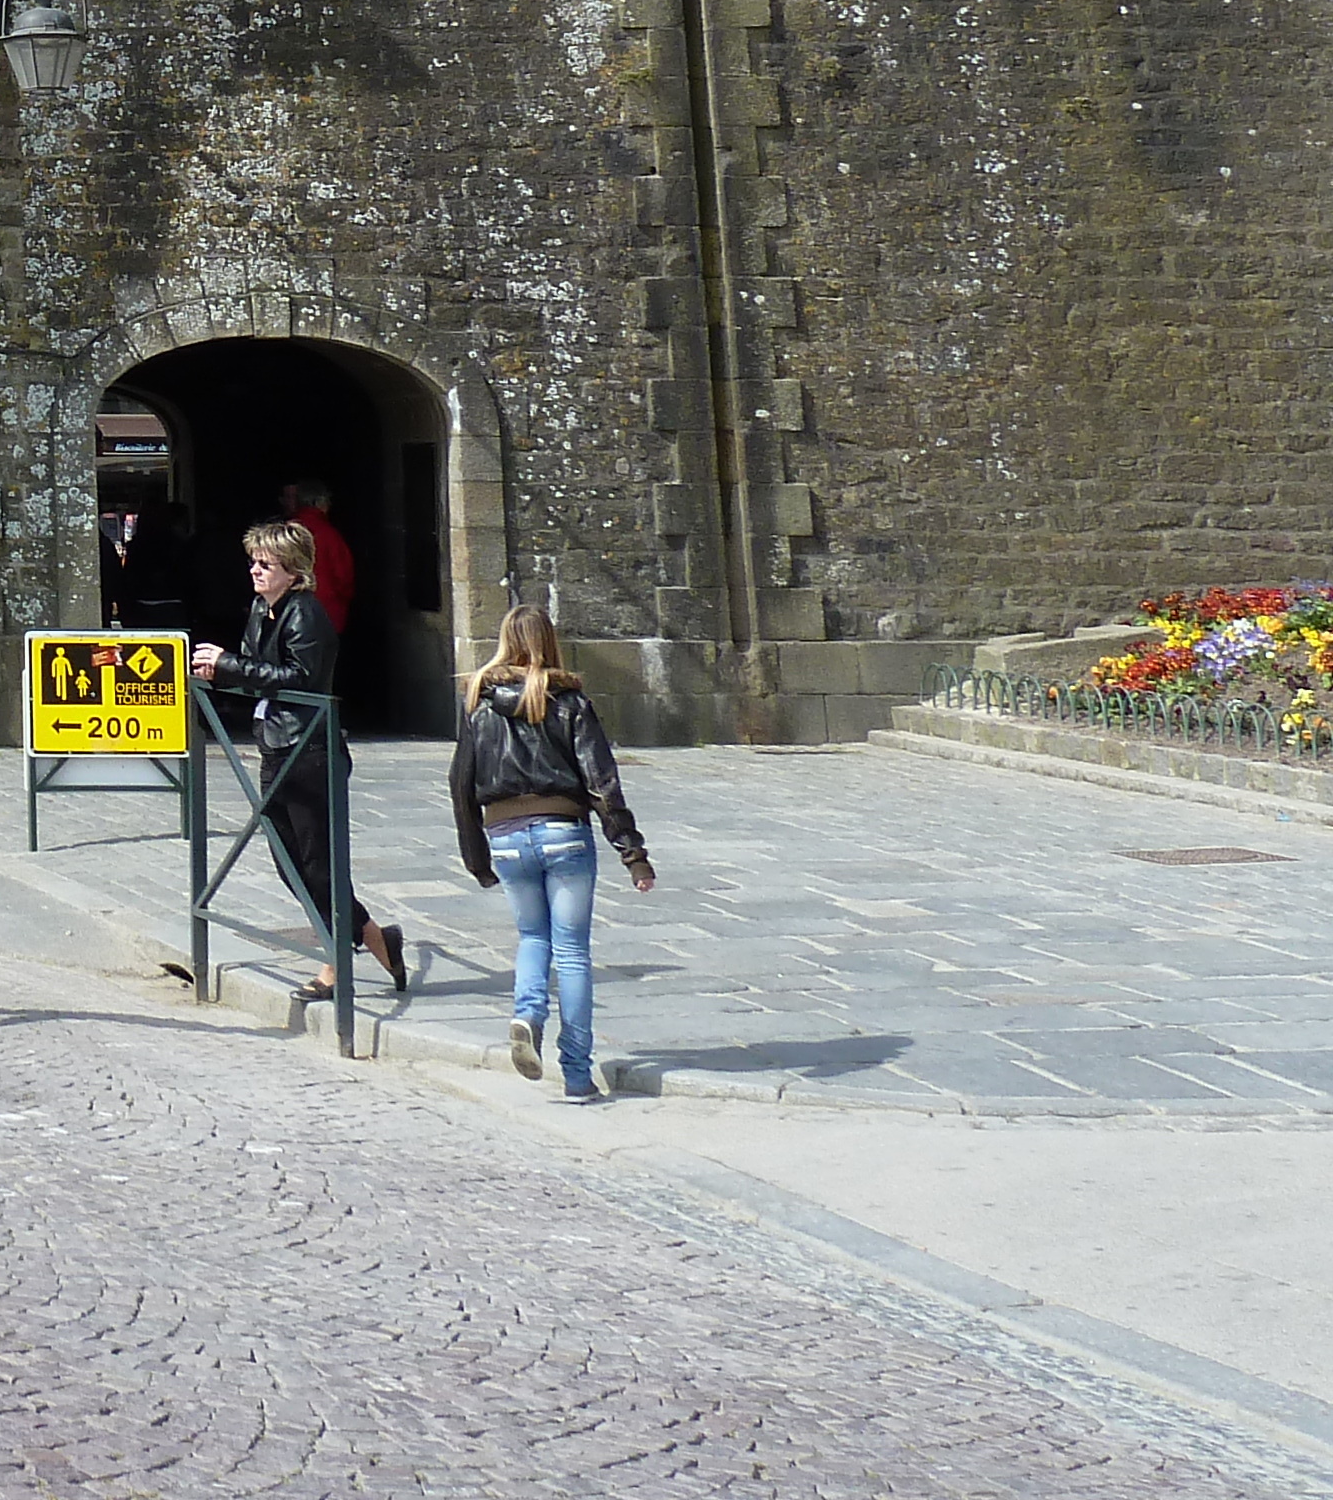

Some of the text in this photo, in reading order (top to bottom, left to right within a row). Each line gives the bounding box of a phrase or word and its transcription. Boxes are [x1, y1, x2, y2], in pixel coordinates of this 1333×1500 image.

[116, 682, 174, 694] OFFICE DE
[116, 694, 174, 705] TOURISME
[88, 716, 163, 739] 200 m
